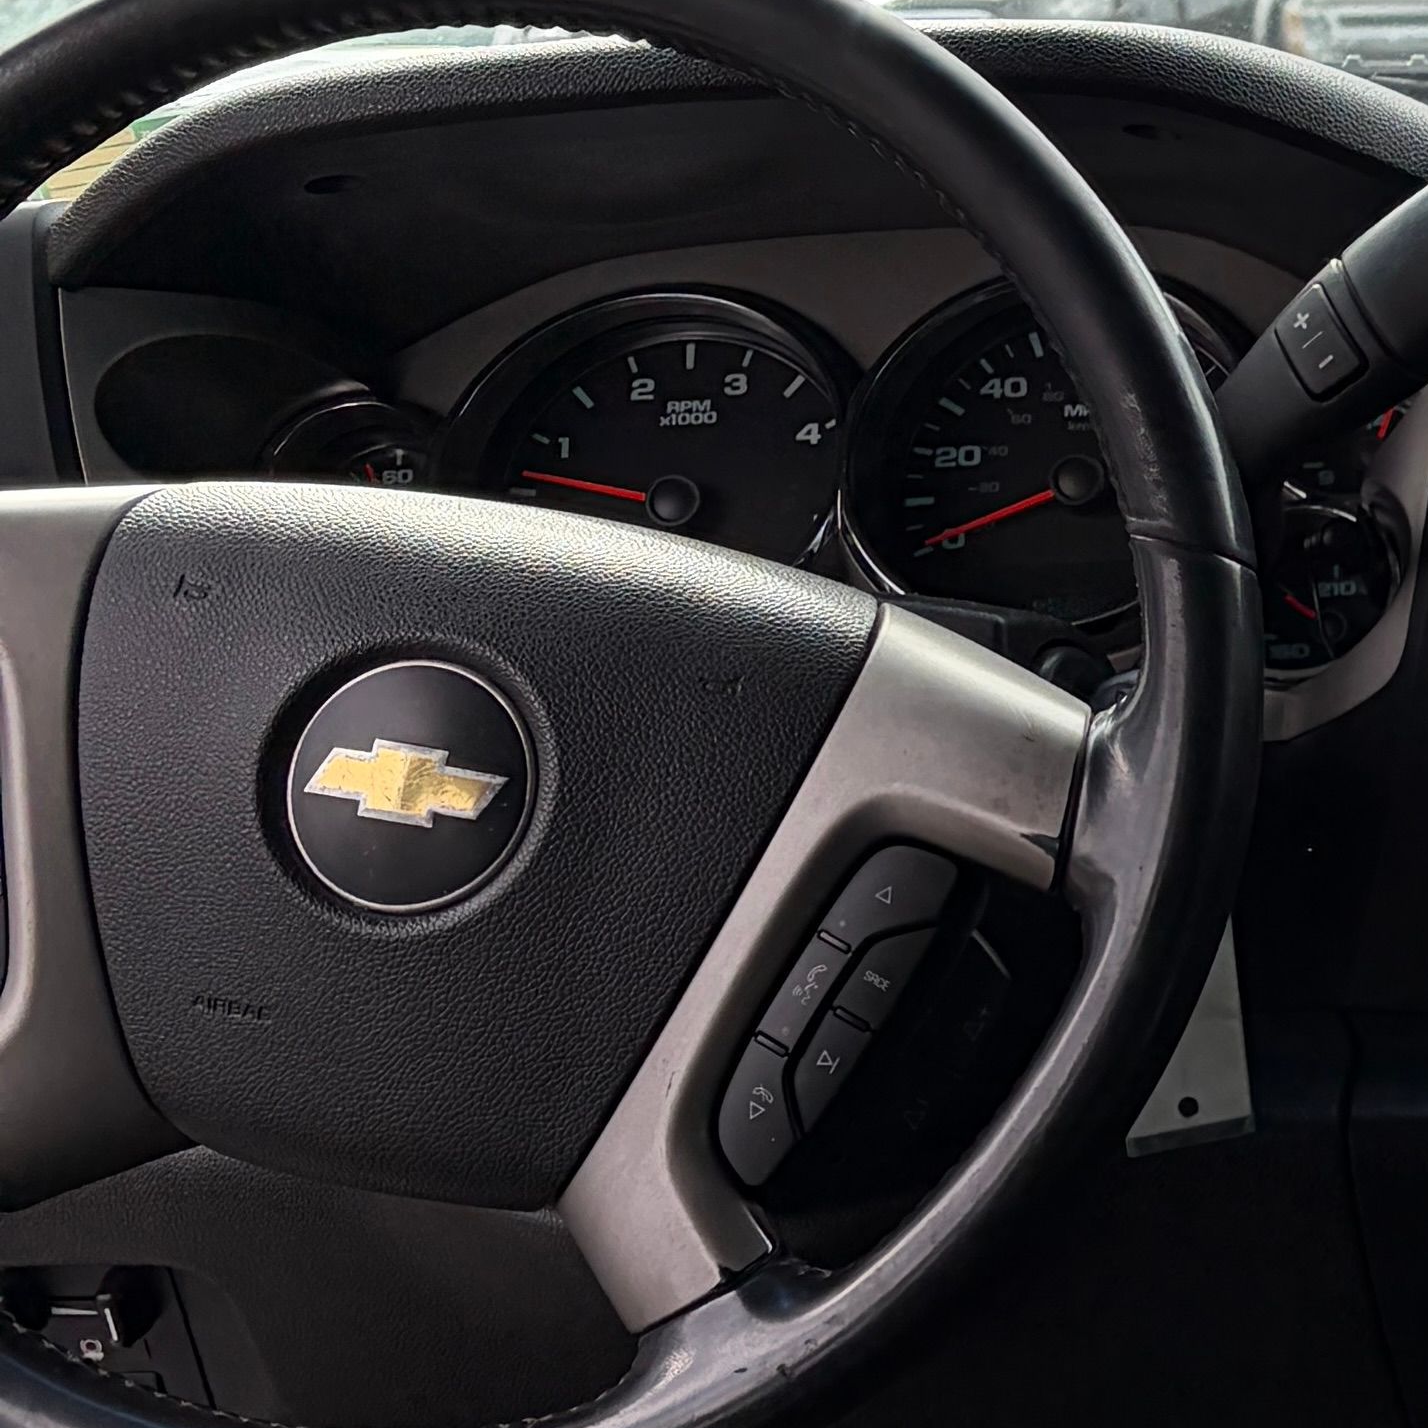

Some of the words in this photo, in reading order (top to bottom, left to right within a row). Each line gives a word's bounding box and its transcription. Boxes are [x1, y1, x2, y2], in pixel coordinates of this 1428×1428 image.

[630, 378, 655, 402] 2
[723, 373, 749, 396] 3
[978, 376, 1029, 400] 40
[659, 410, 717, 427] x1000
[666, 399, 712, 415] RPM
[795, 422, 822, 445] 4
[557, 436, 571, 459] 1
[933, 444, 982, 468] 20
